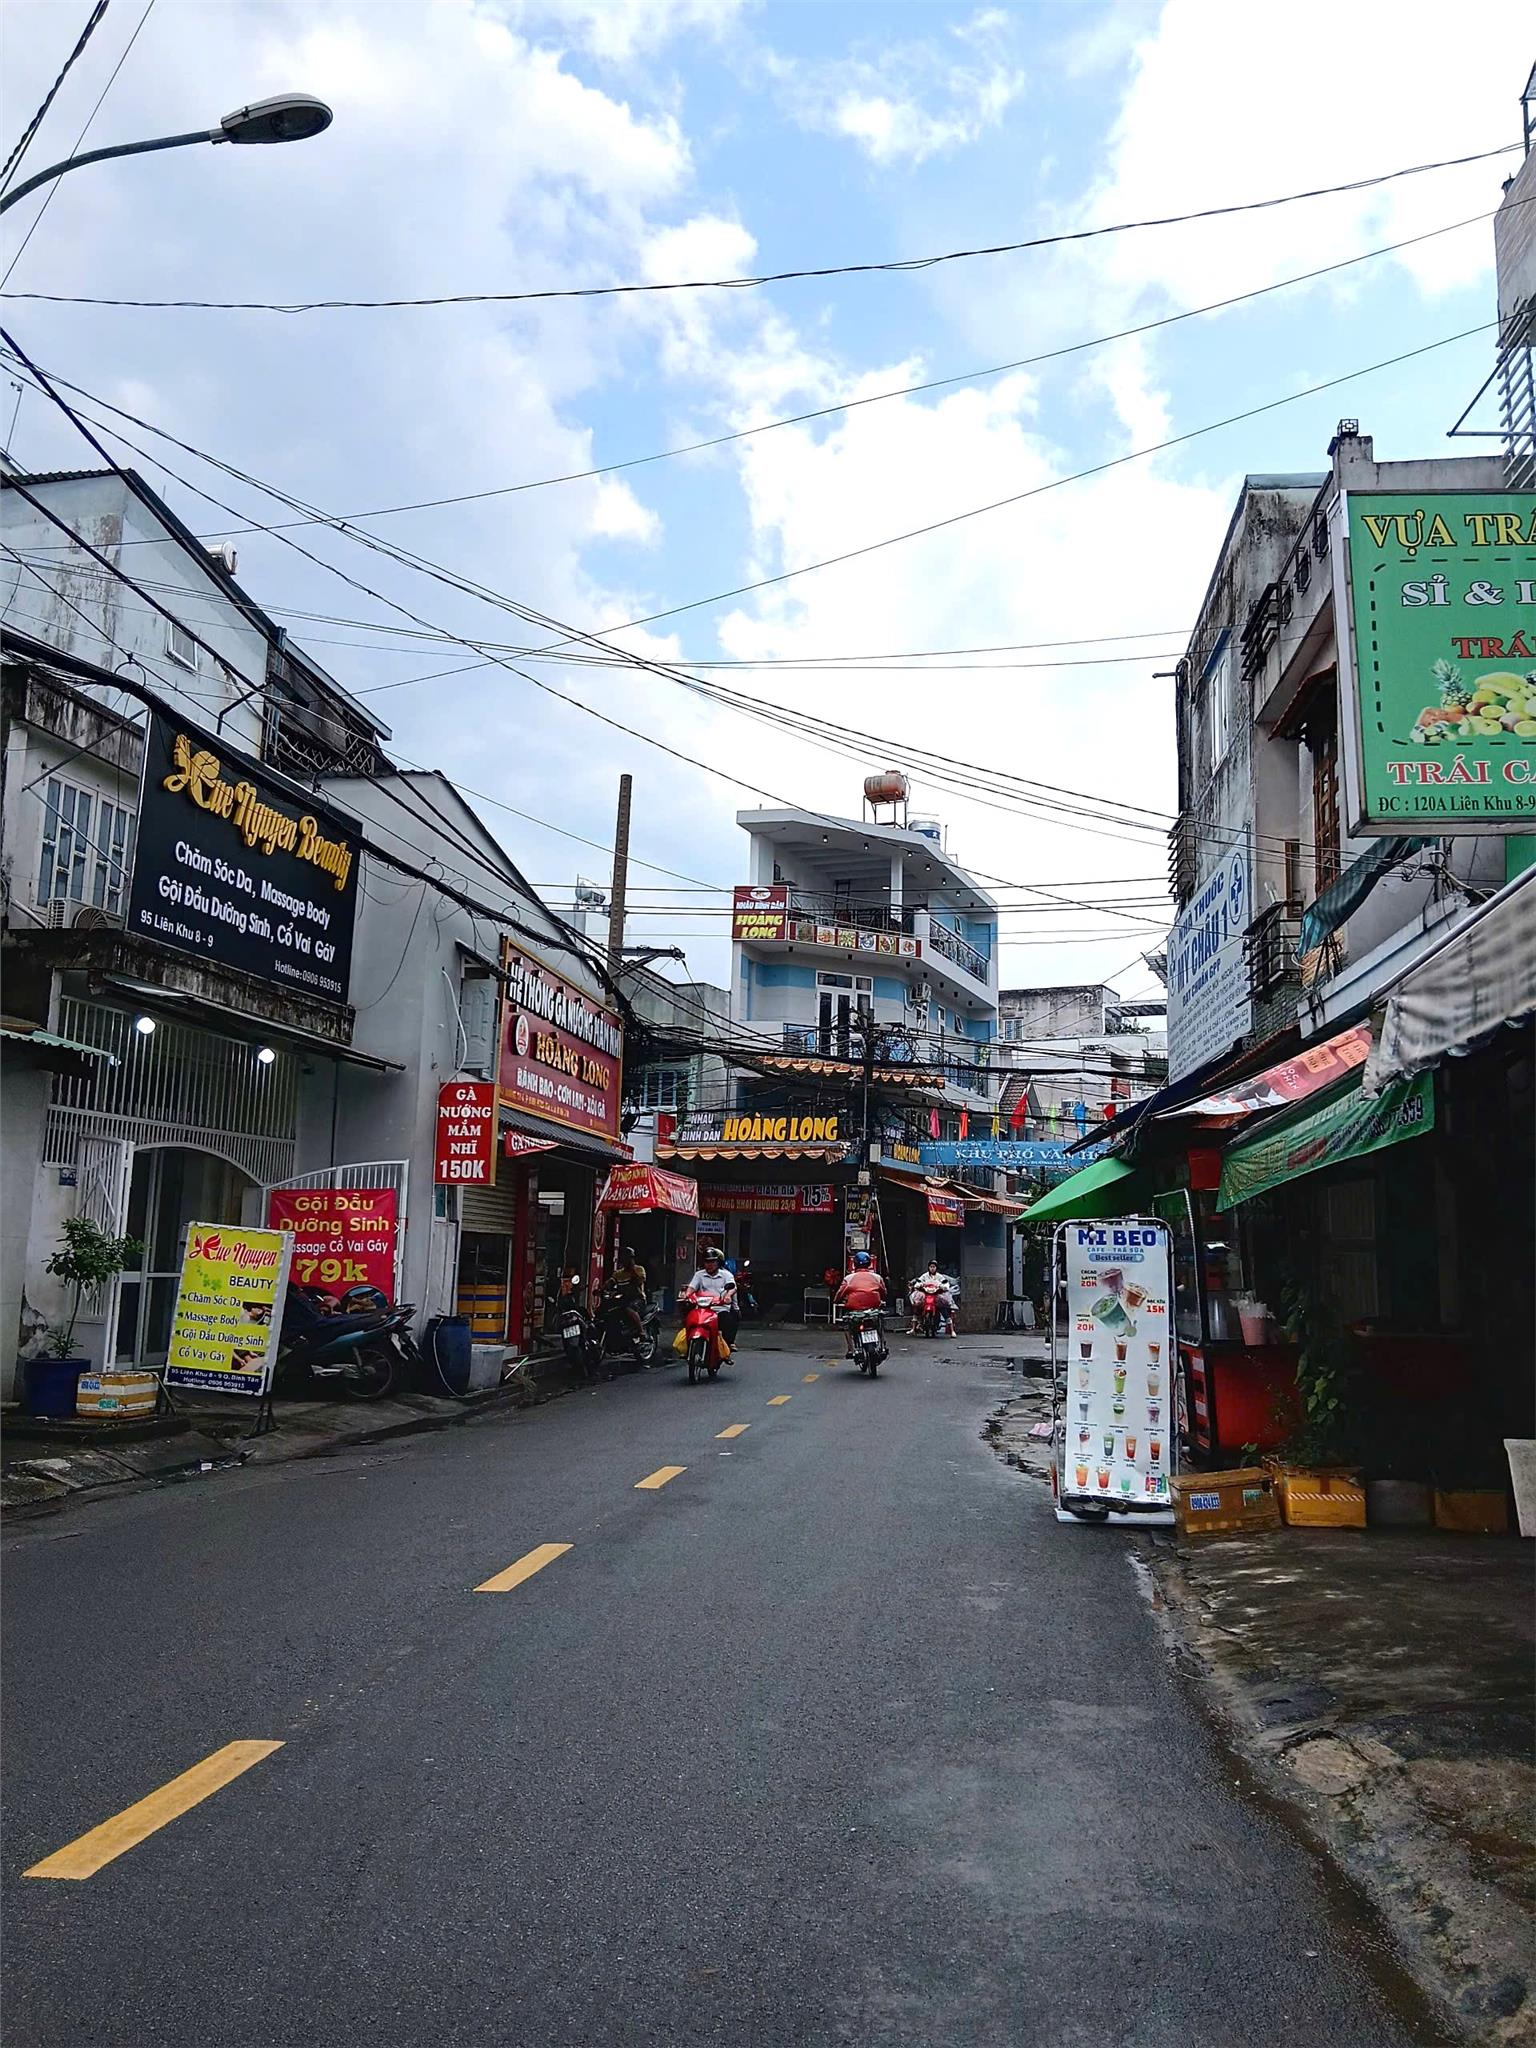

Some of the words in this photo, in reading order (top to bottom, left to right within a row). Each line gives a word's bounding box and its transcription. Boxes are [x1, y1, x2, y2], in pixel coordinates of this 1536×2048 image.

[1361, 509, 1457, 556] VỰA
[1464, 508, 1536, 546] TR
[1464, 581, 1504, 605] &
[1387, 754, 1492, 785] TRÁI
[1503, 760, 1536, 785] C
[1378, 796, 1400, 812] ĐC
[1414, 797, 1447, 811] 120A
[1451, 795, 1480, 811] Liên
[1484, 795, 1512, 811] Khu
[296, 816, 352, 891] Beauty
[175, 841, 212, 875] Chăm
[214, 858, 235, 885] Sóc
[236, 869, 256, 898] Da,
[261, 880, 305, 917] Massage
[306, 900, 330, 930] Body
[1194, 871, 1224, 922] THUỐC
[159, 876, 182, 905] Gội
[184, 885, 209, 913] Đầu
[277, 923, 293, 946] Cổ
[295, 931, 312, 954] Vai
[736, 911, 783, 925] HOÀNG
[141, 909, 152, 925] 95
[154, 913, 174, 933] Liên
[175, 922, 193, 941] Khu
[195, 930, 201, 943] 8
[208, 934, 214, 948] 9
[741, 927, 777, 938] LONG
[1191, 912, 1219, 976] CHÂU
[1221, 900, 1227, 941] 1
[536, 1032, 579, 1076] HOÀNG
[582, 1056, 610, 1091] LONG
[456, 1086, 477, 1100] GÀ
[539, 1076, 554, 1099] BAO
[440, 1103, 491, 1118] NƯỚNG
[723, 1111, 787, 1141] HOÀNG
[789, 1116, 838, 1141] LONG
[450, 1139, 477, 1154] NHĨ
[955, 1149, 993, 1161] KHU
[998, 1147, 1033, 1160] PHỐ
[440, 1159, 485, 1178] 150K
[295, 1197, 328, 1214] Gội
[335, 1193, 374, 1211] Đầu
[801, 1185, 831, 1206] 15%
[280, 1217, 343, 1236] Dưỡng
[349, 1216, 389, 1232] Sinh
[330, 1236, 343, 1253] Cổ
[347, 1240, 363, 1252] Vai
[367, 1239, 388, 1254] Gáy
[1078, 1230, 1107, 1245] MI
[1113, 1230, 1156, 1246] BEO
[233, 1242, 277, 1270] Nguyen
[297, 1258, 368, 1283] 79k
[229, 1276, 273, 1290] BEAUTY
[185, 1311, 218, 1326] Massage
[220, 1314, 240, 1327] Body
[181, 1328, 197, 1341] Gội
[246, 1336, 264, 1346] Sinh
